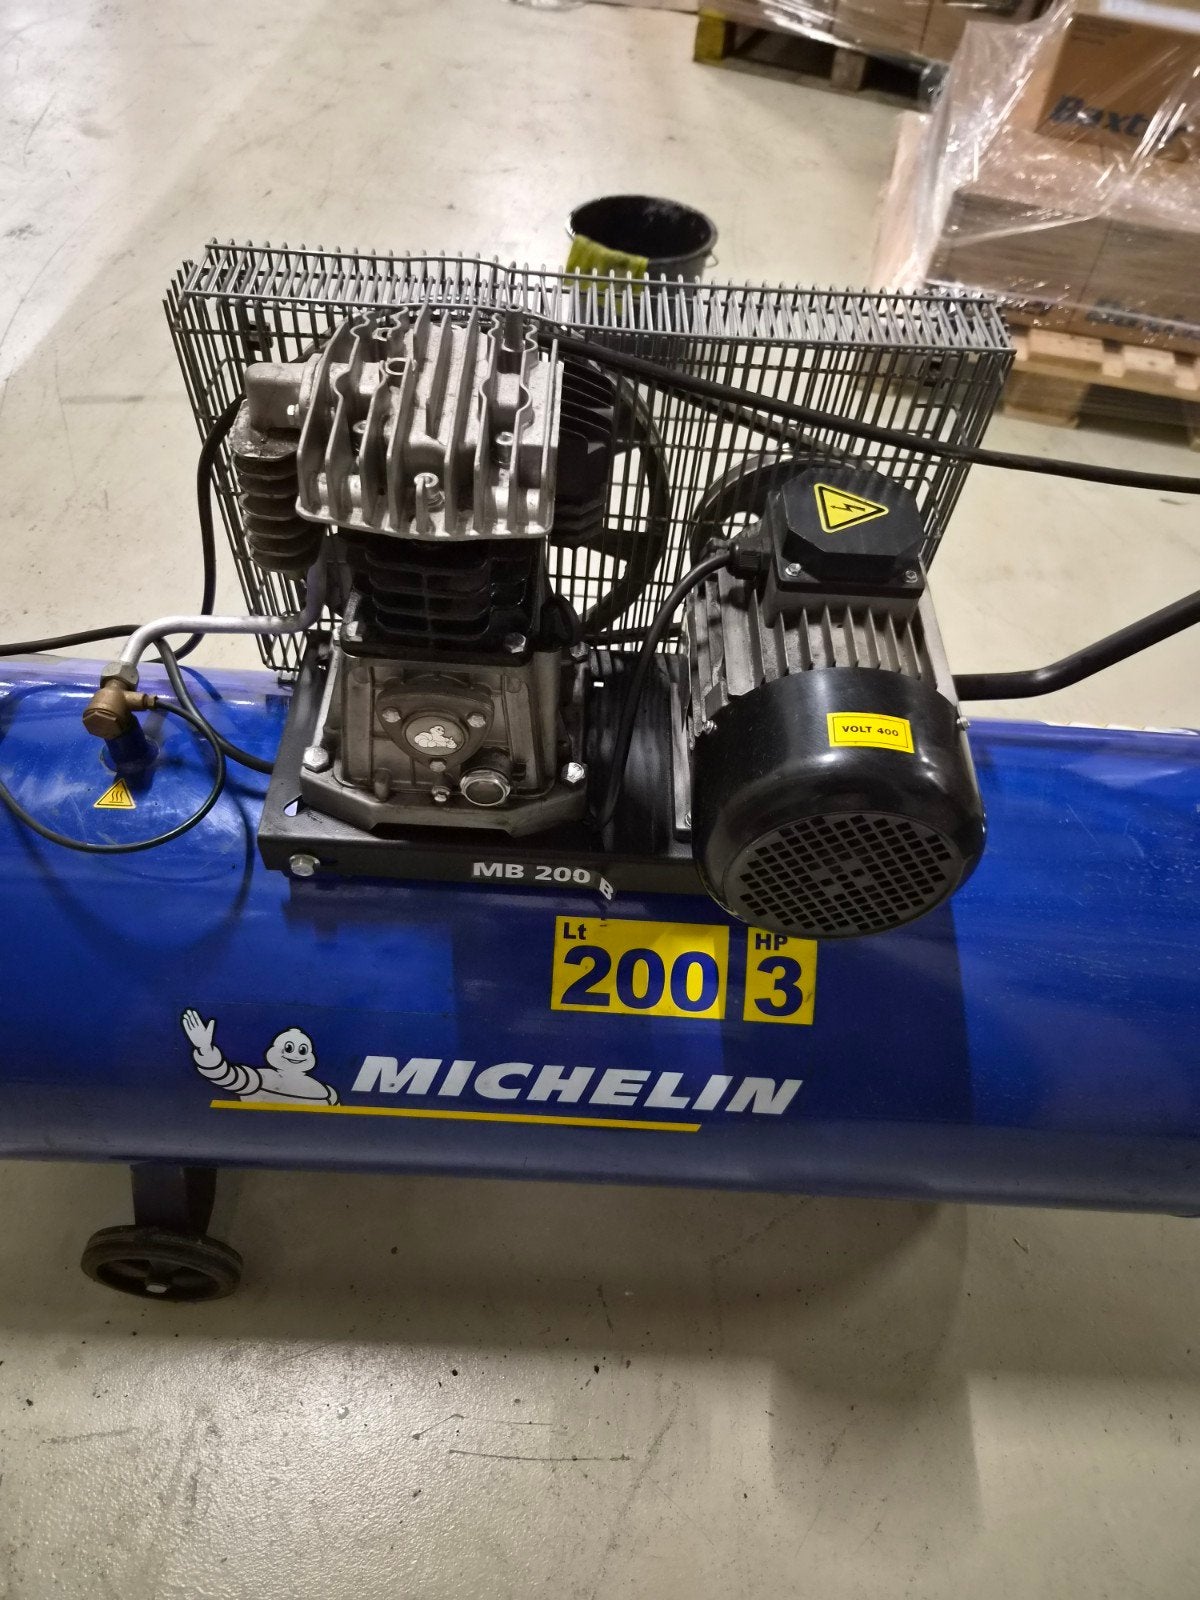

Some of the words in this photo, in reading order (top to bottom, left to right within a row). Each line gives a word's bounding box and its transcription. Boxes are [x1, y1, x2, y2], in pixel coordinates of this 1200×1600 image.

[842, 725, 872, 733] VOLT
[877, 727, 899, 737] 400
[472, 862, 525, 879] MB
[534, 865, 591, 884] 200
[599, 876, 614, 901] B
[563, 922, 587, 940] Lt
[755, 932, 788, 951] HP
[560, 944, 720, 1013] 200
[754, 955, 804, 1017] 3
[351, 1055, 803, 1115] MICHELIN
